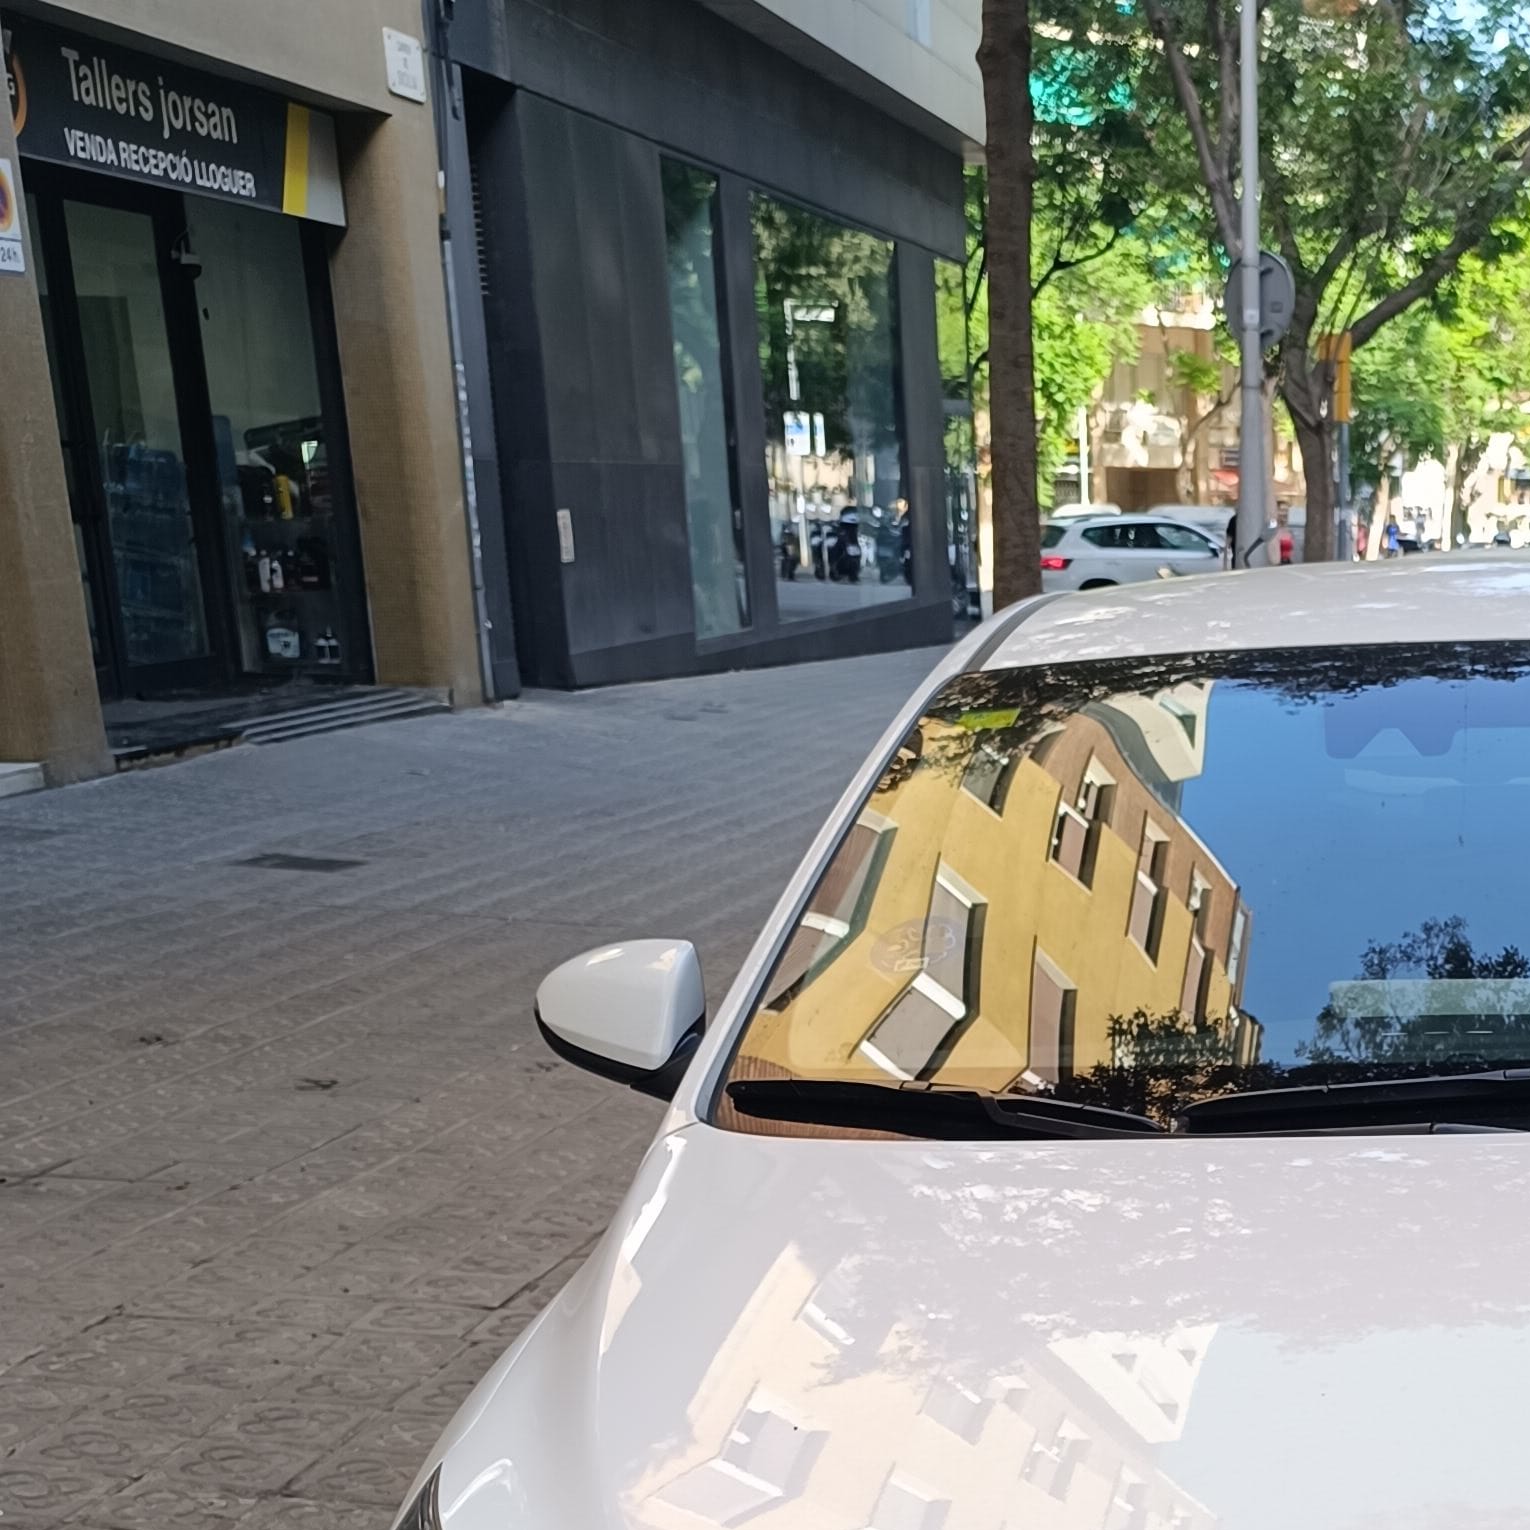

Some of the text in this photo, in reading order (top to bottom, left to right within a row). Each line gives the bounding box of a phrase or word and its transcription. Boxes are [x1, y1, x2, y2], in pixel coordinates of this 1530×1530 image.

[61, 47, 238, 144] Tallers jorsan
[64, 127, 257, 197] VENDA RECEPCIÓ LLOGUER
